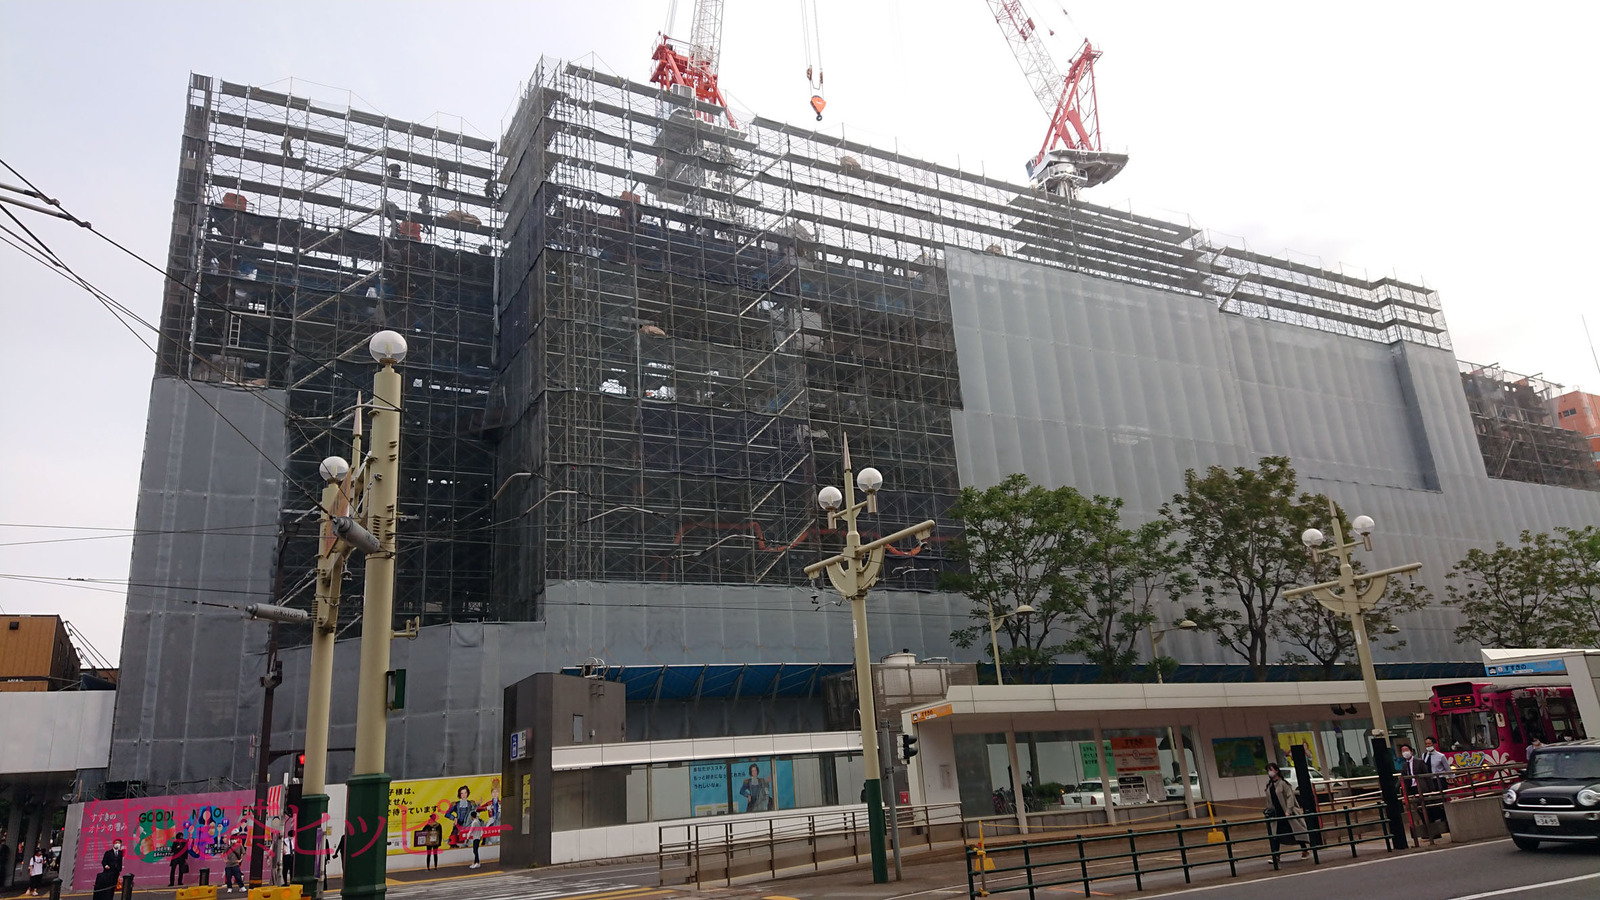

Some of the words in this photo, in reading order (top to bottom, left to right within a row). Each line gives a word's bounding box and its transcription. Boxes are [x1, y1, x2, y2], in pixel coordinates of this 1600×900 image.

[1454, 751, 1485, 768] ビッグ
[138, 810, 174, 823] GOOD!
